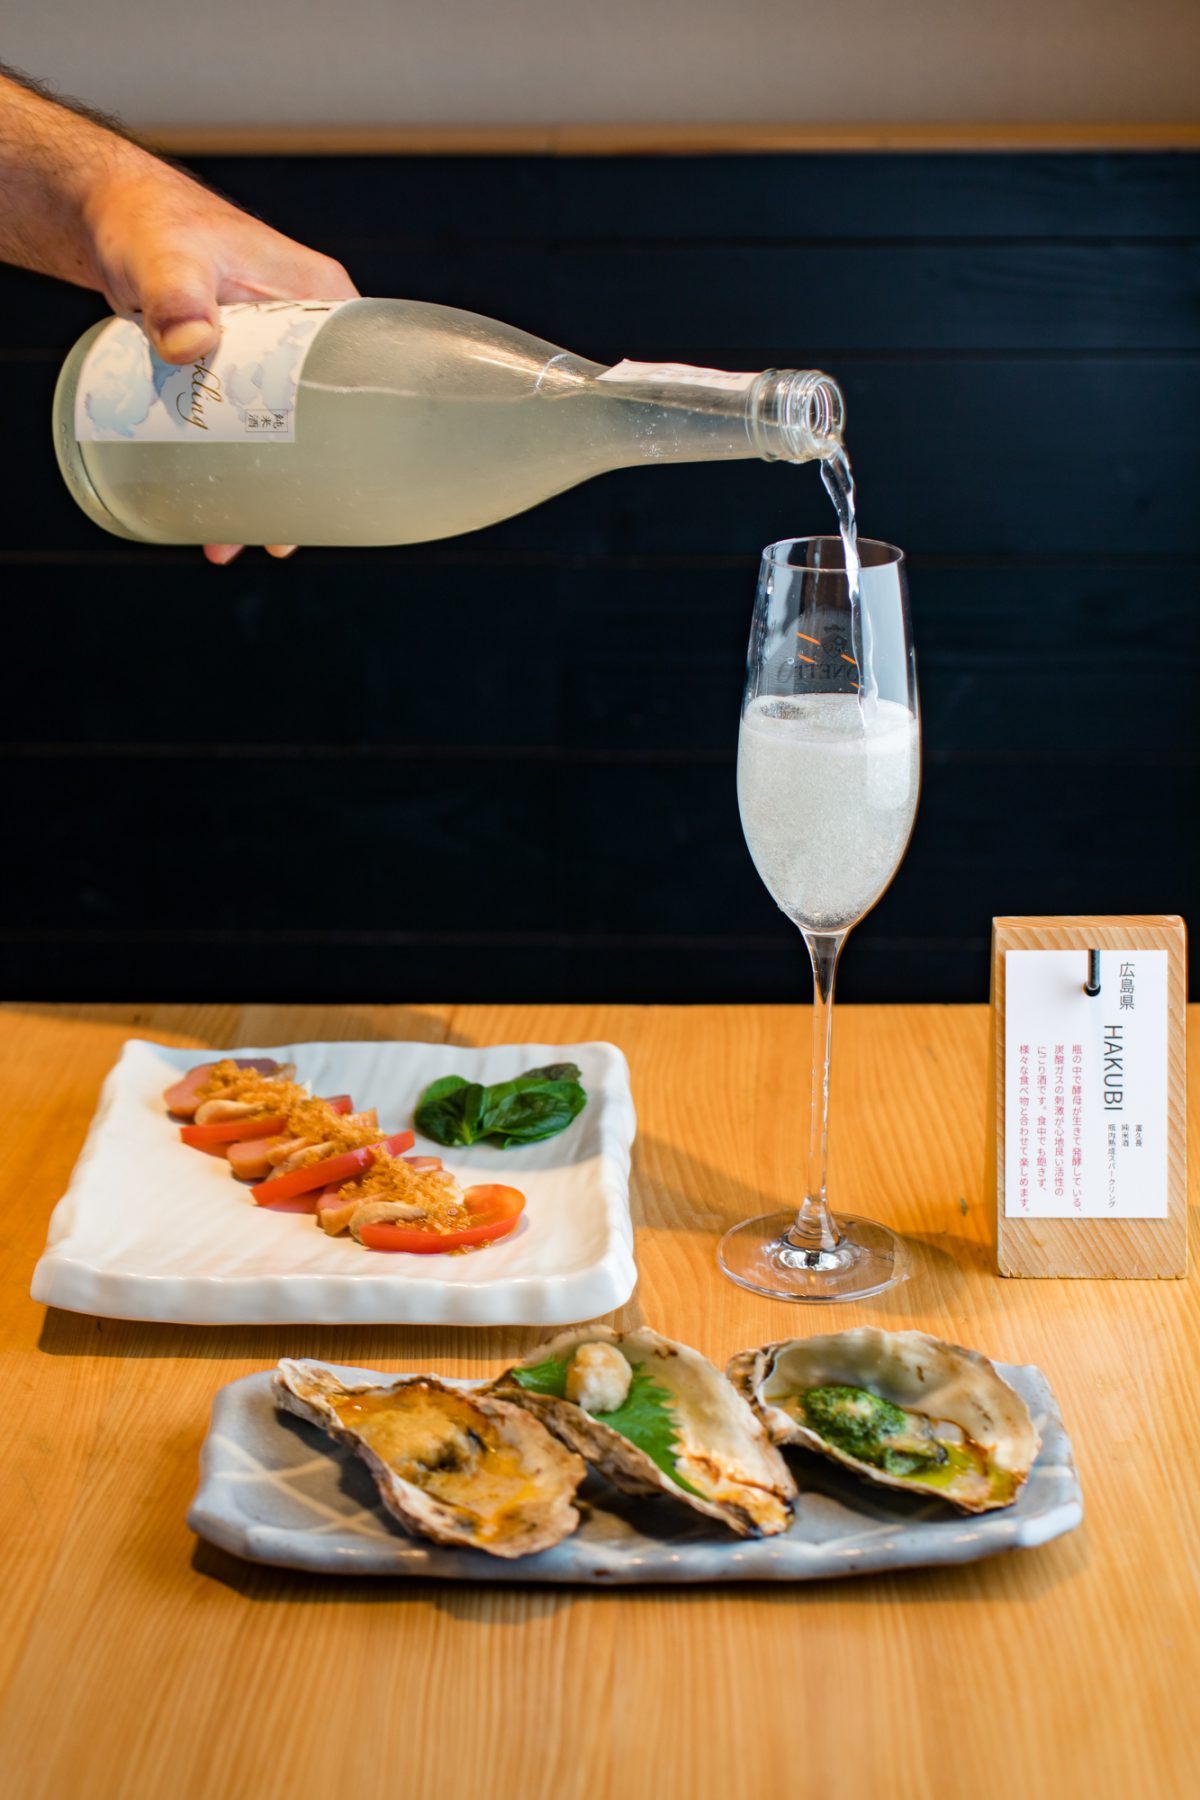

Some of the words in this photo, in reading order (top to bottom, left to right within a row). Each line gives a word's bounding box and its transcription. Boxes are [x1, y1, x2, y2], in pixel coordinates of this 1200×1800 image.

[176, 355, 224, 430] rkling
[248, 412, 285, 430] 純米酒
[1118, 961, 1136, 1011] 広島県
[1103, 1025, 1124, 1111] HAKUBI
[1120, 1123, 1130, 1148] 純米酒
